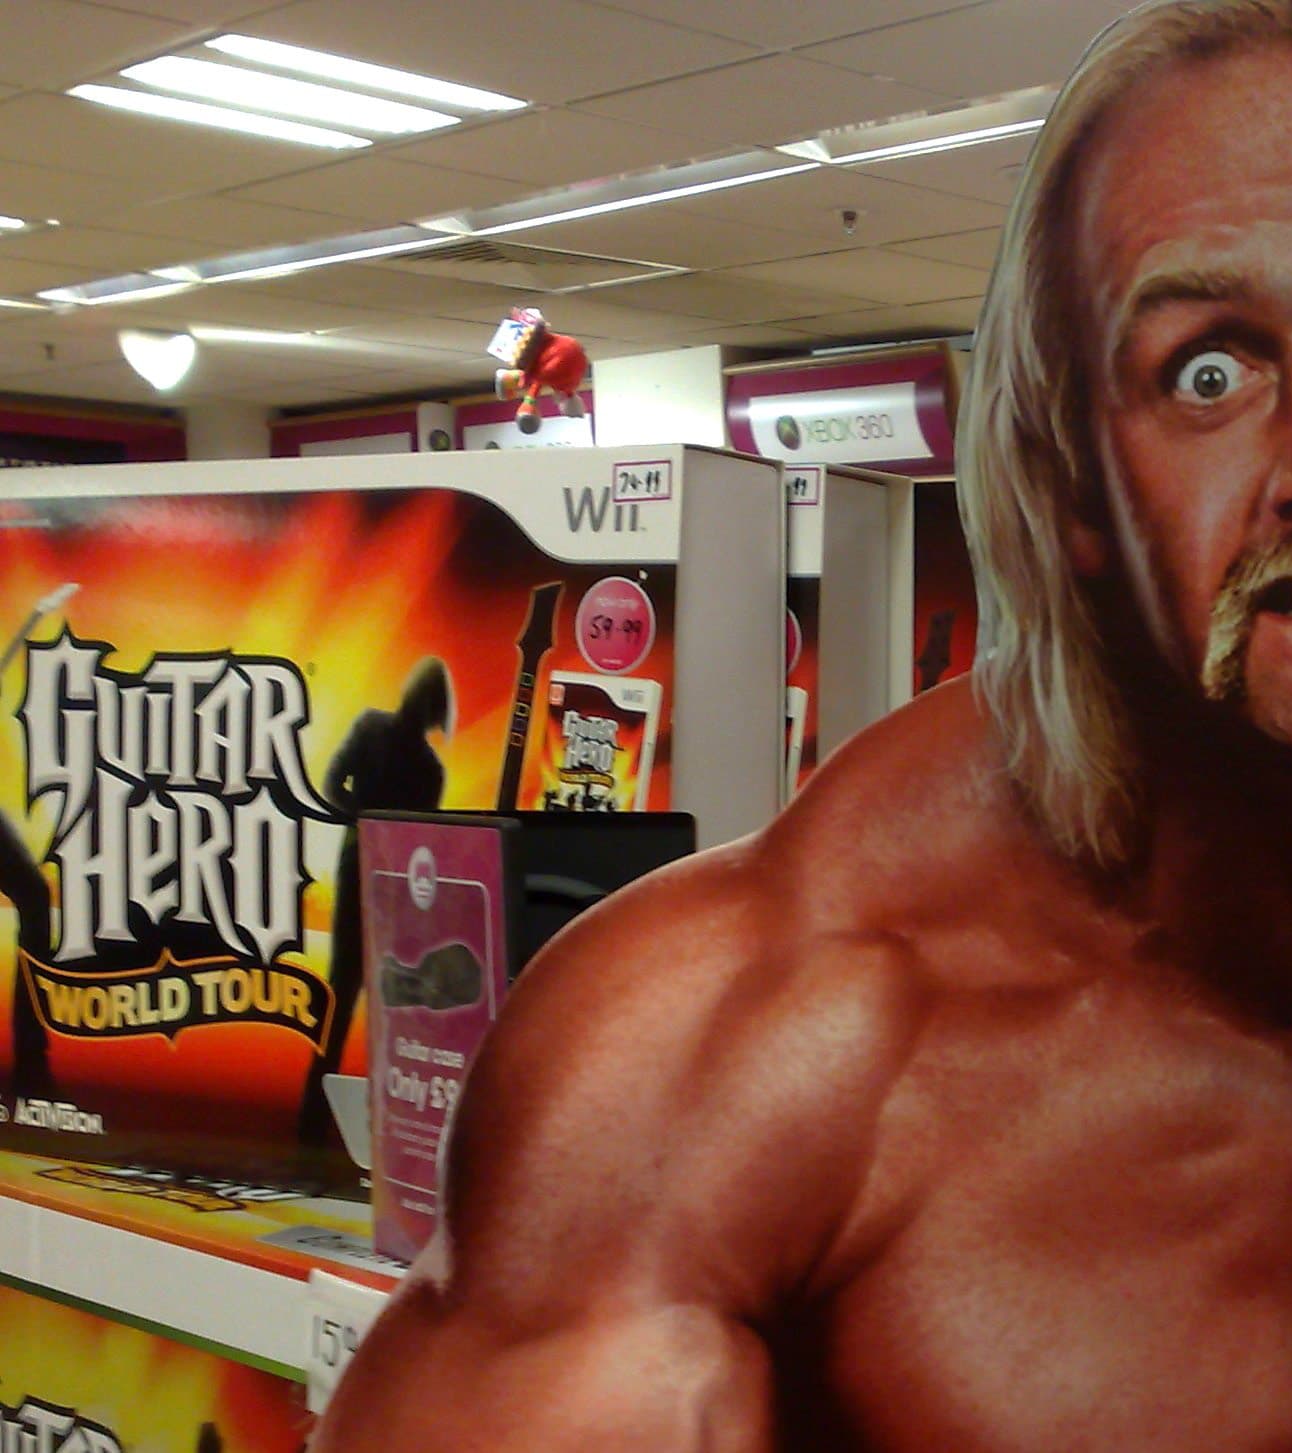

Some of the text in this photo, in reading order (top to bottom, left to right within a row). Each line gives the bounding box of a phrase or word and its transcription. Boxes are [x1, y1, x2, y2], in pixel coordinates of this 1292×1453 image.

[562, 485, 639, 533] Wii
[36, 967, 319, 1031] WORLD TOUR
